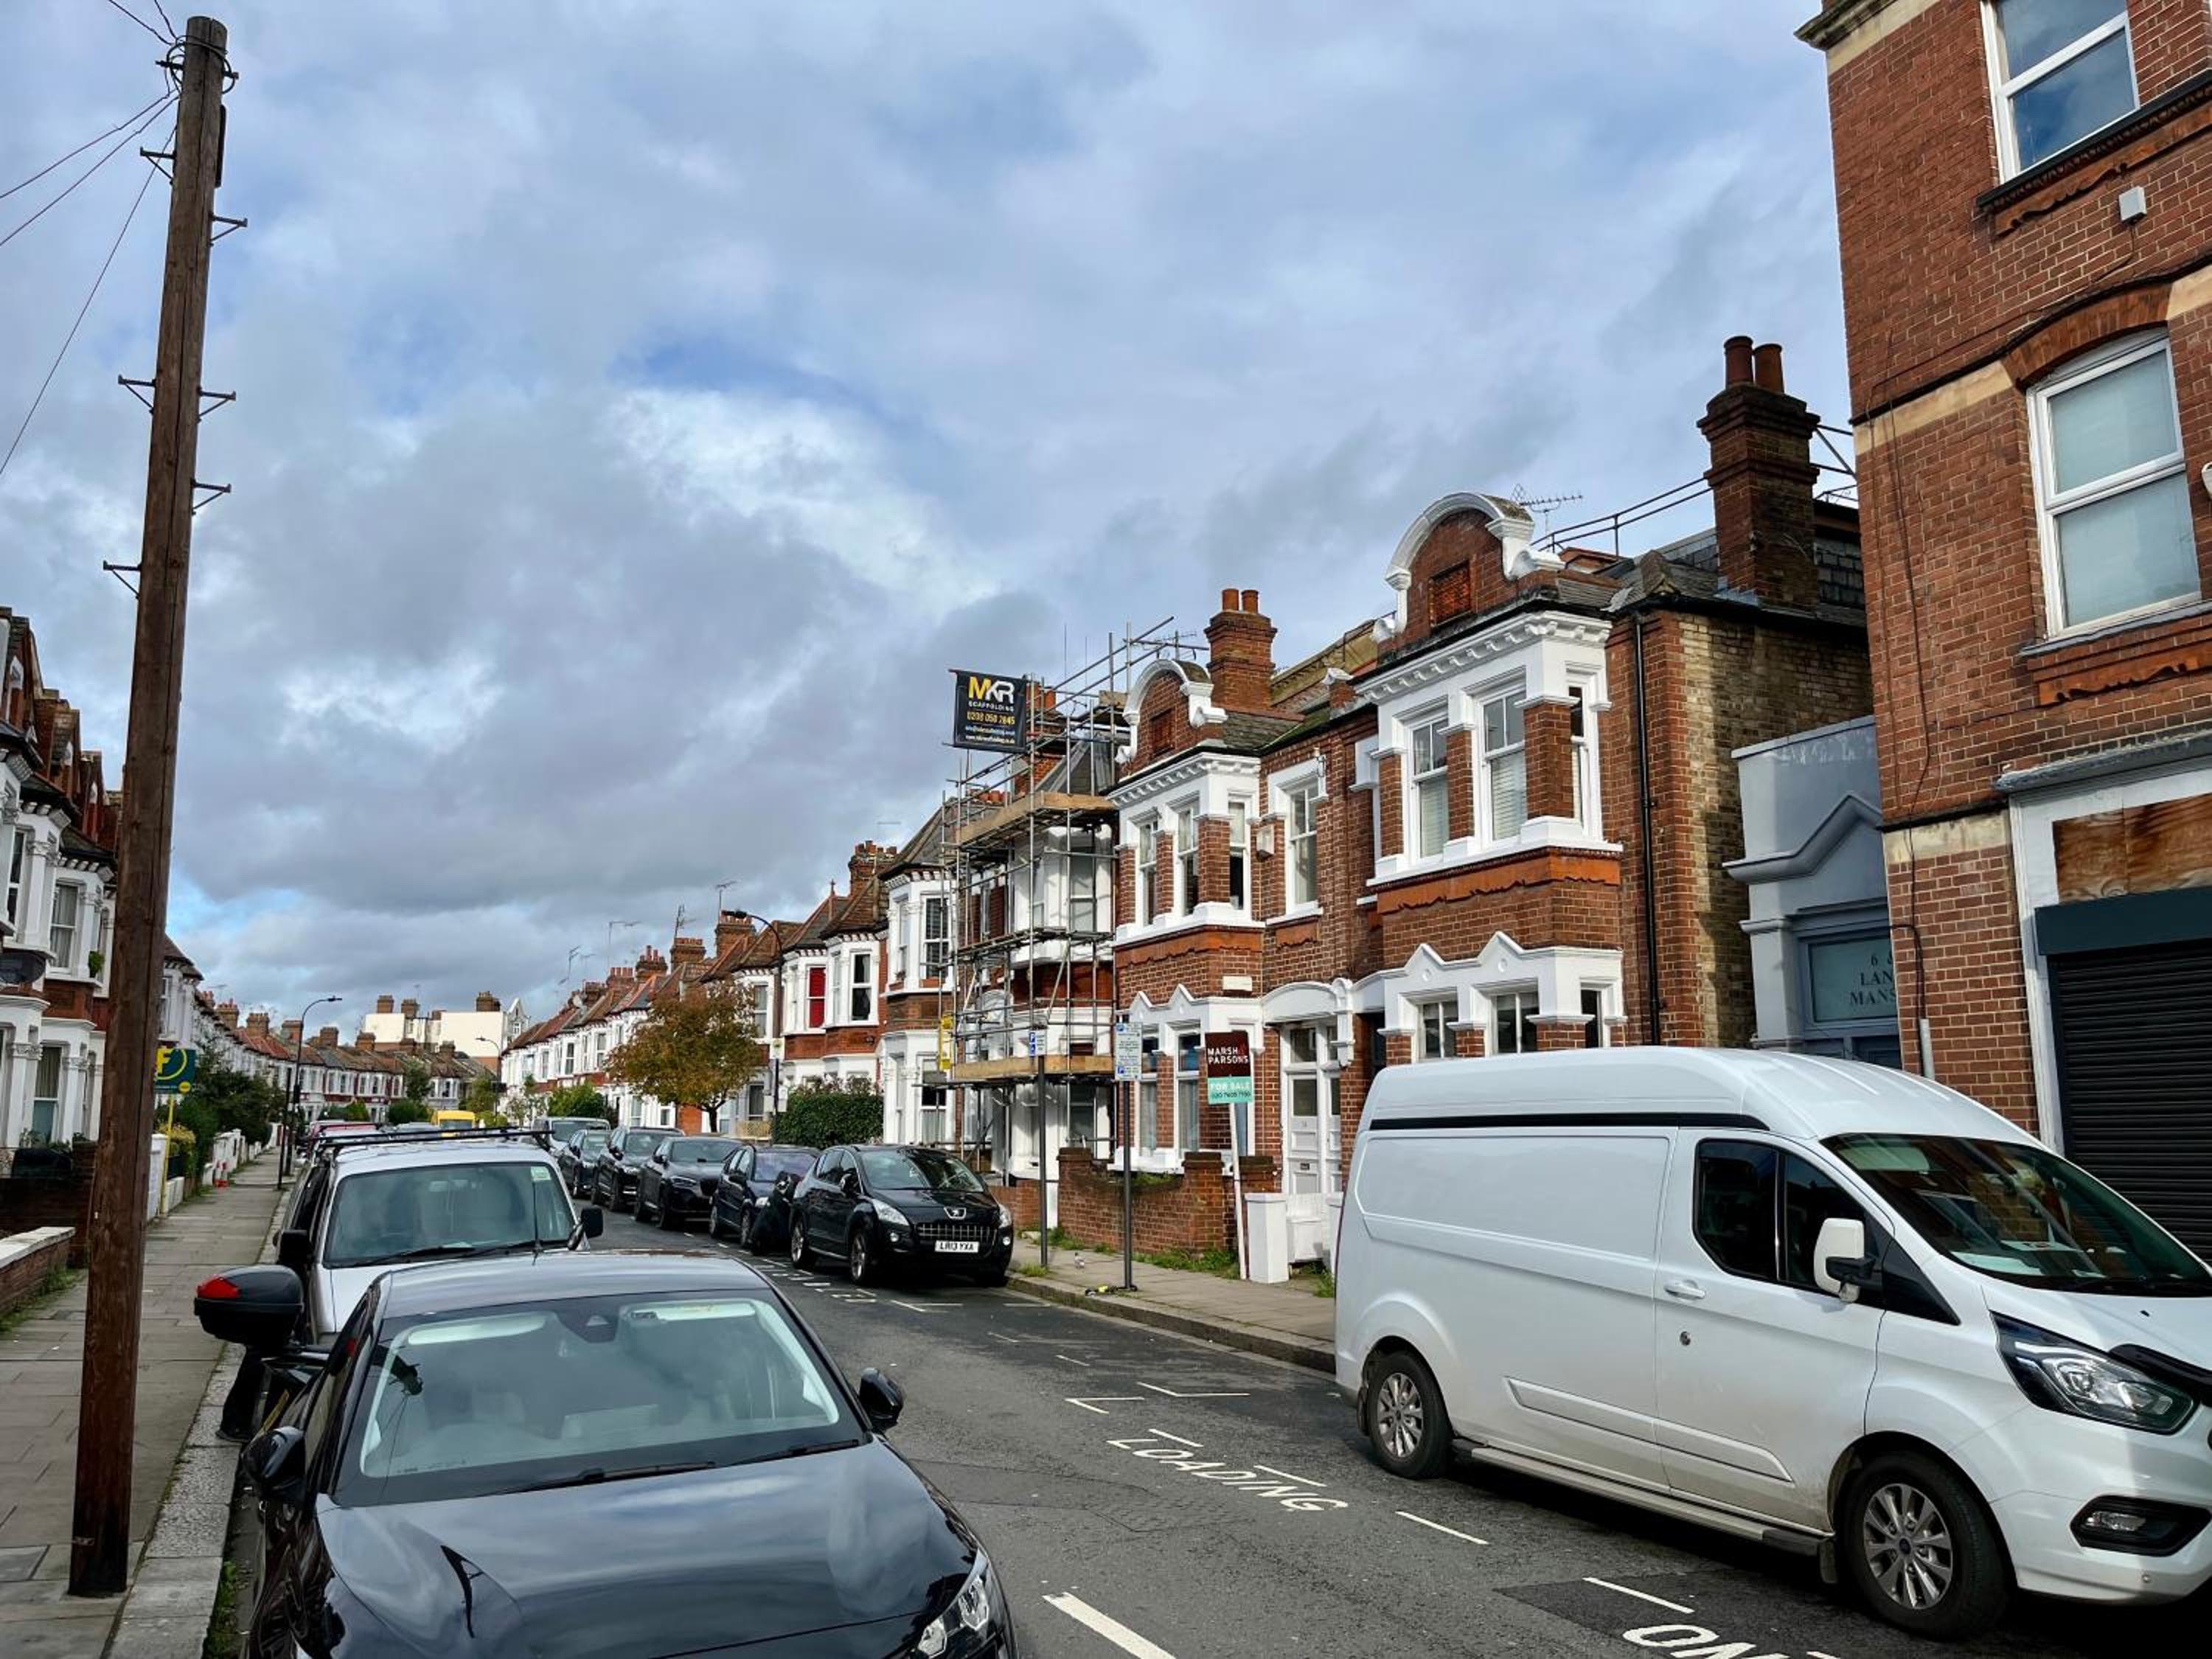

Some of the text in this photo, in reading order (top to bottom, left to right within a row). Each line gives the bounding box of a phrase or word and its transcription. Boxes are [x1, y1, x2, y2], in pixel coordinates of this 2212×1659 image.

[968, 676, 1015, 703] MKR
[1207, 1046, 1238, 1055] MARSH
[1208, 1055, 1249, 1065] PARSONS
[1210, 1082, 1250, 1091] FOR SALE
[1106, 1439, 1349, 1512] LOADING
